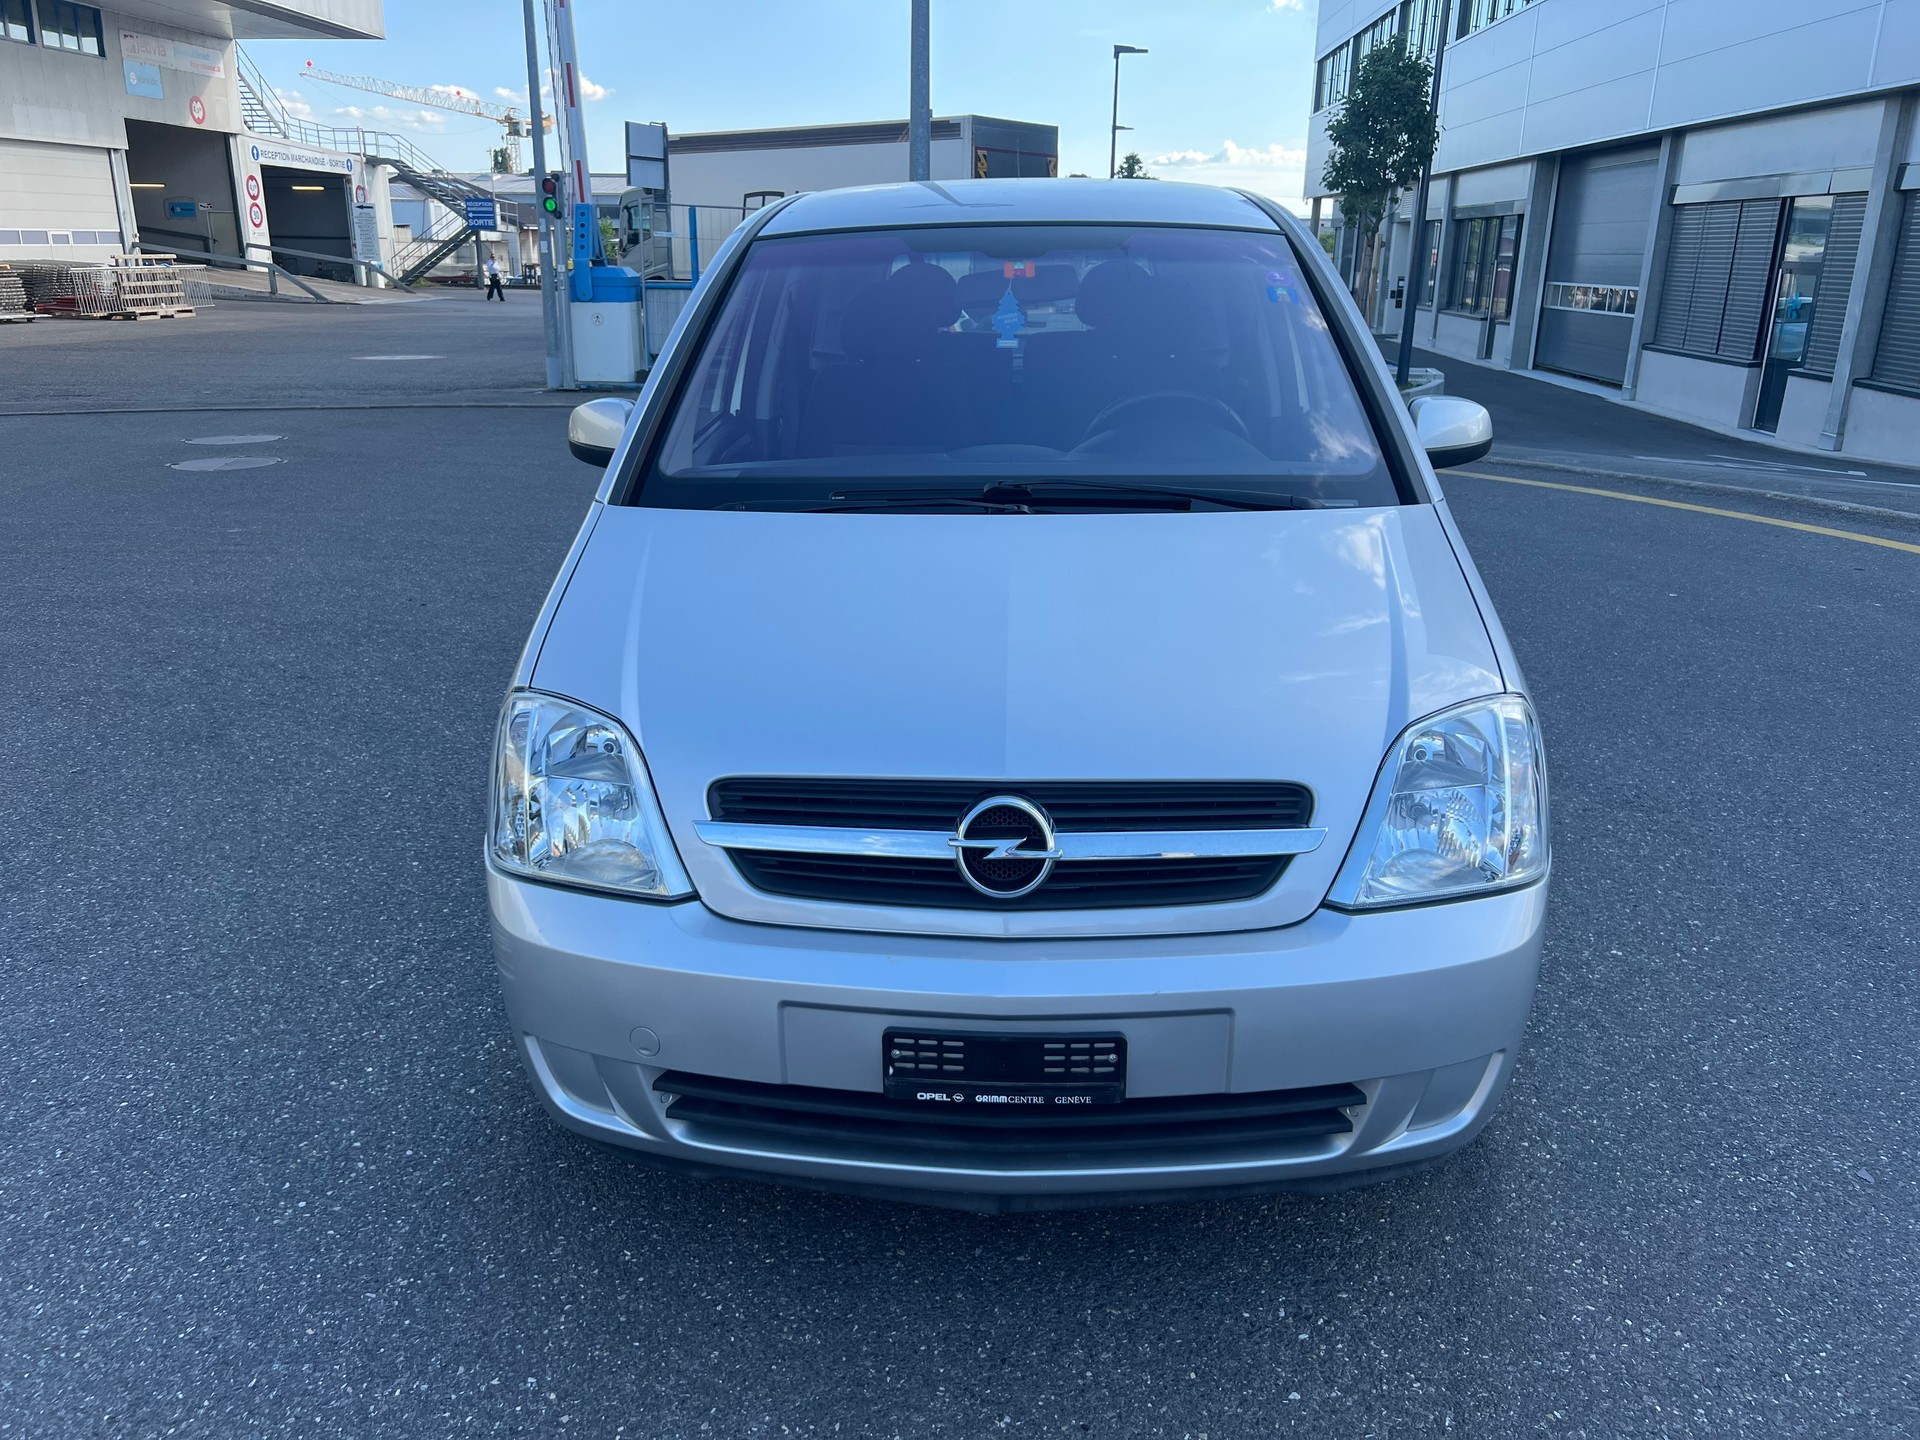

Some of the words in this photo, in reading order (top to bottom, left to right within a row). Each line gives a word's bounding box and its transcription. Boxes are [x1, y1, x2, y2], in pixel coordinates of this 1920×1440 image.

[260, 149, 290, 161] RECEPTION
[291, 154, 326, 166] MARCHANDISE
[329, 159, 346, 169] SORTIE
[917, 1092, 951, 1101] OPEL
